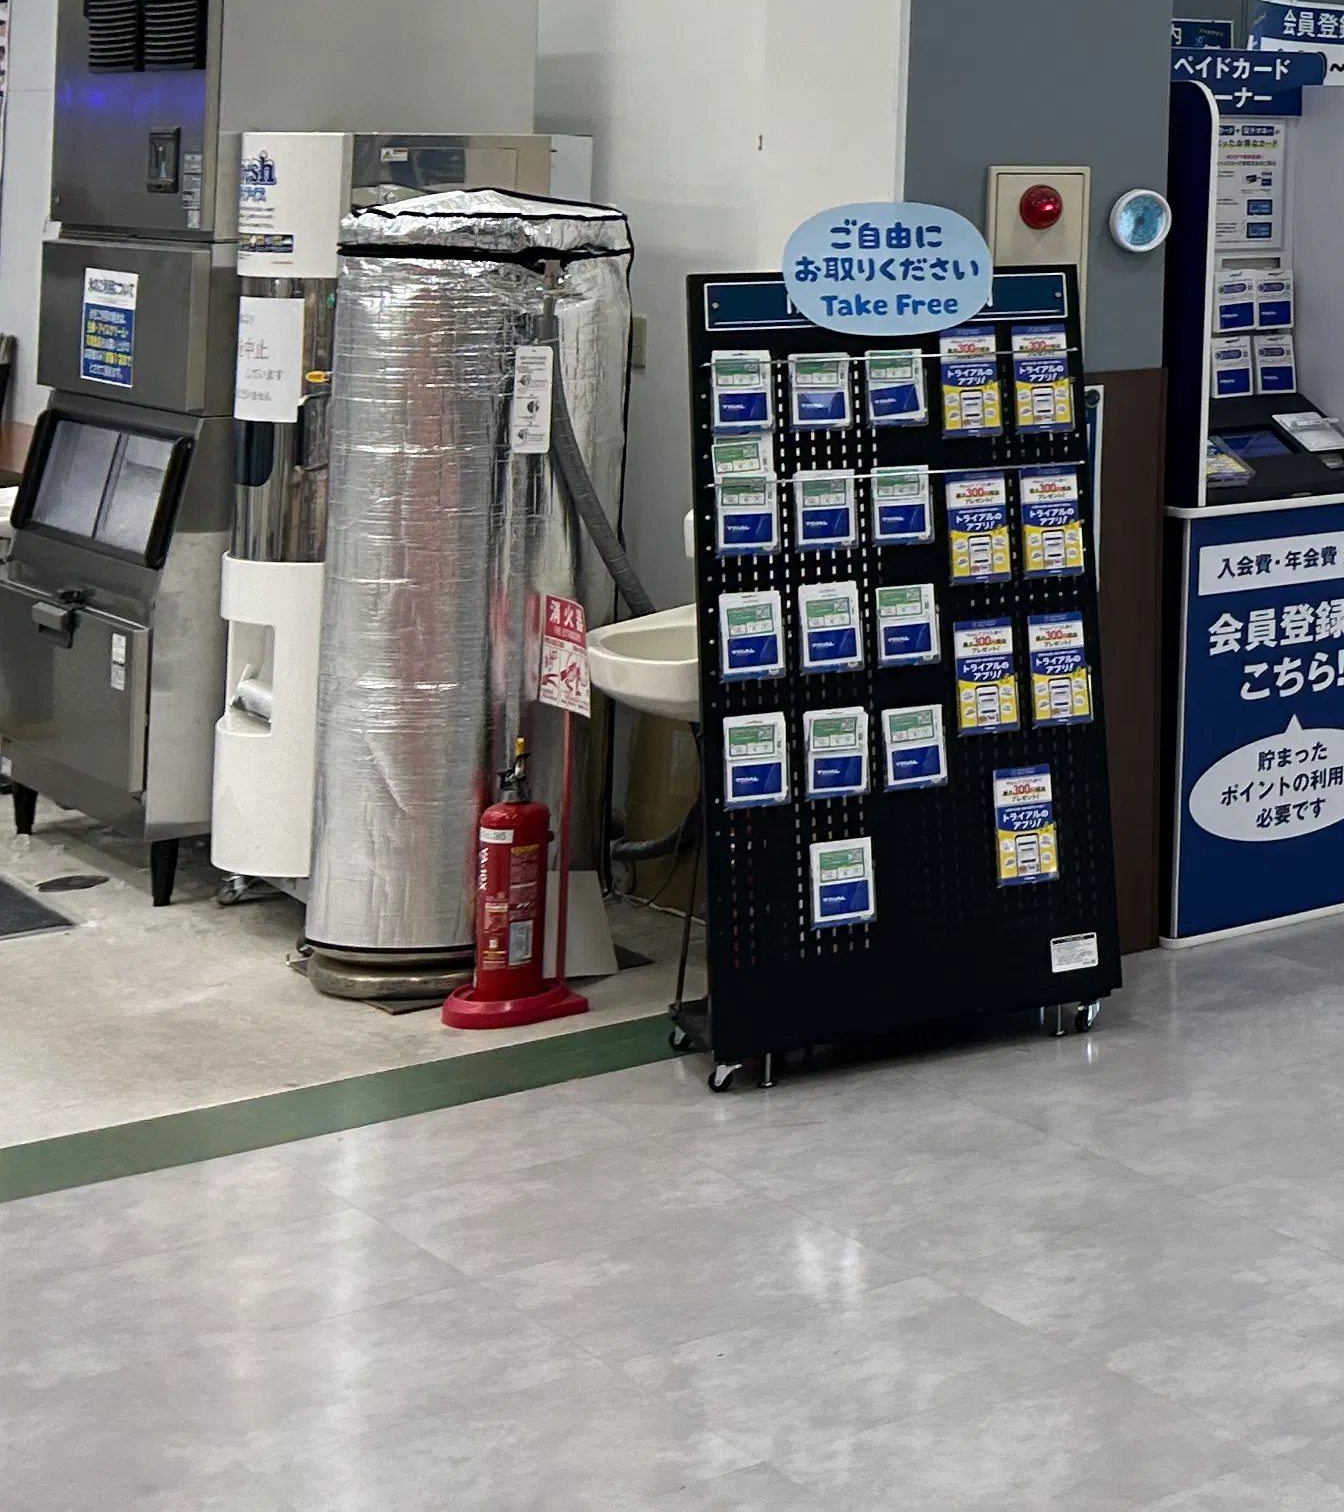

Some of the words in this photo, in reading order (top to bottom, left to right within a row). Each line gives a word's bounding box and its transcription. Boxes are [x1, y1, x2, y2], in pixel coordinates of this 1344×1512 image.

[1174, 56, 1290, 80] ペイドカード
[830, 219, 943, 249] ご自由に
[795, 256, 979, 283] お取りください
[820, 294, 888, 317] Take
[896, 294, 959, 316] Free
[947, 369, 993, 379] トライアルの
[1019, 365, 1064, 375] トライアルの
[956, 514, 1002, 523] トライアルの
[1029, 508, 1075, 518] トライアルの
[1217, 545, 1337, 579] 入会費・年会費
[963, 662, 1009, 673] トライアルの
[1035, 655, 1081, 666] トライアルの
[1258, 742, 1328, 772] 貯まった
[1003, 810, 1049, 822] トライアルの
[1256, 797, 1326, 829] 必要です
